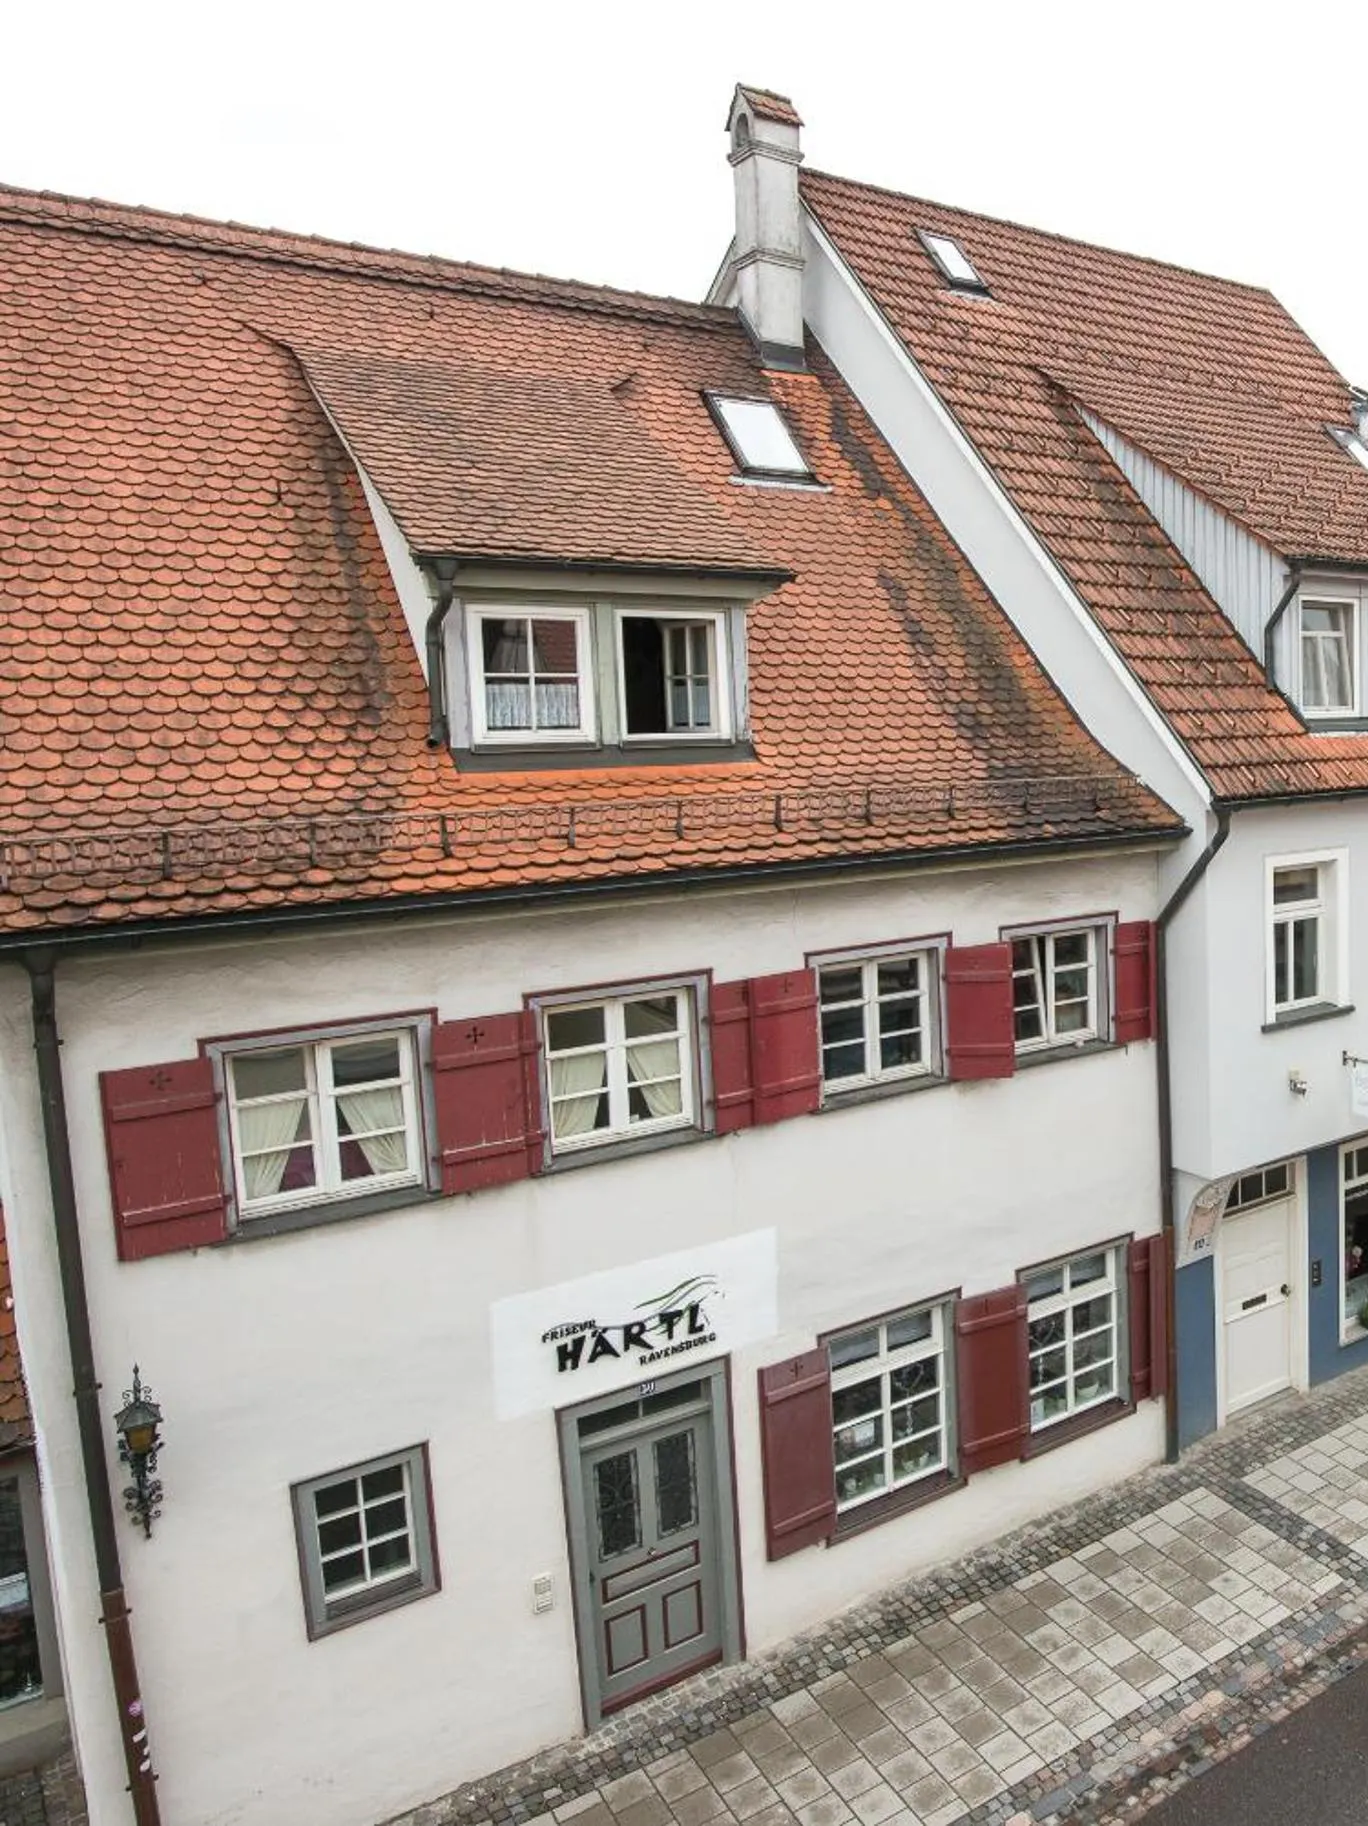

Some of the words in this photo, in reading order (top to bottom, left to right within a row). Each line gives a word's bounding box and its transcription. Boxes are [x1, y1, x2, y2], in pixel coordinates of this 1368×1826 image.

[541, 1319, 598, 1343] FRISEUR
[556, 1301, 705, 1373] HÄRTL
[638, 1332, 717, 1366] RAVENSBURG
